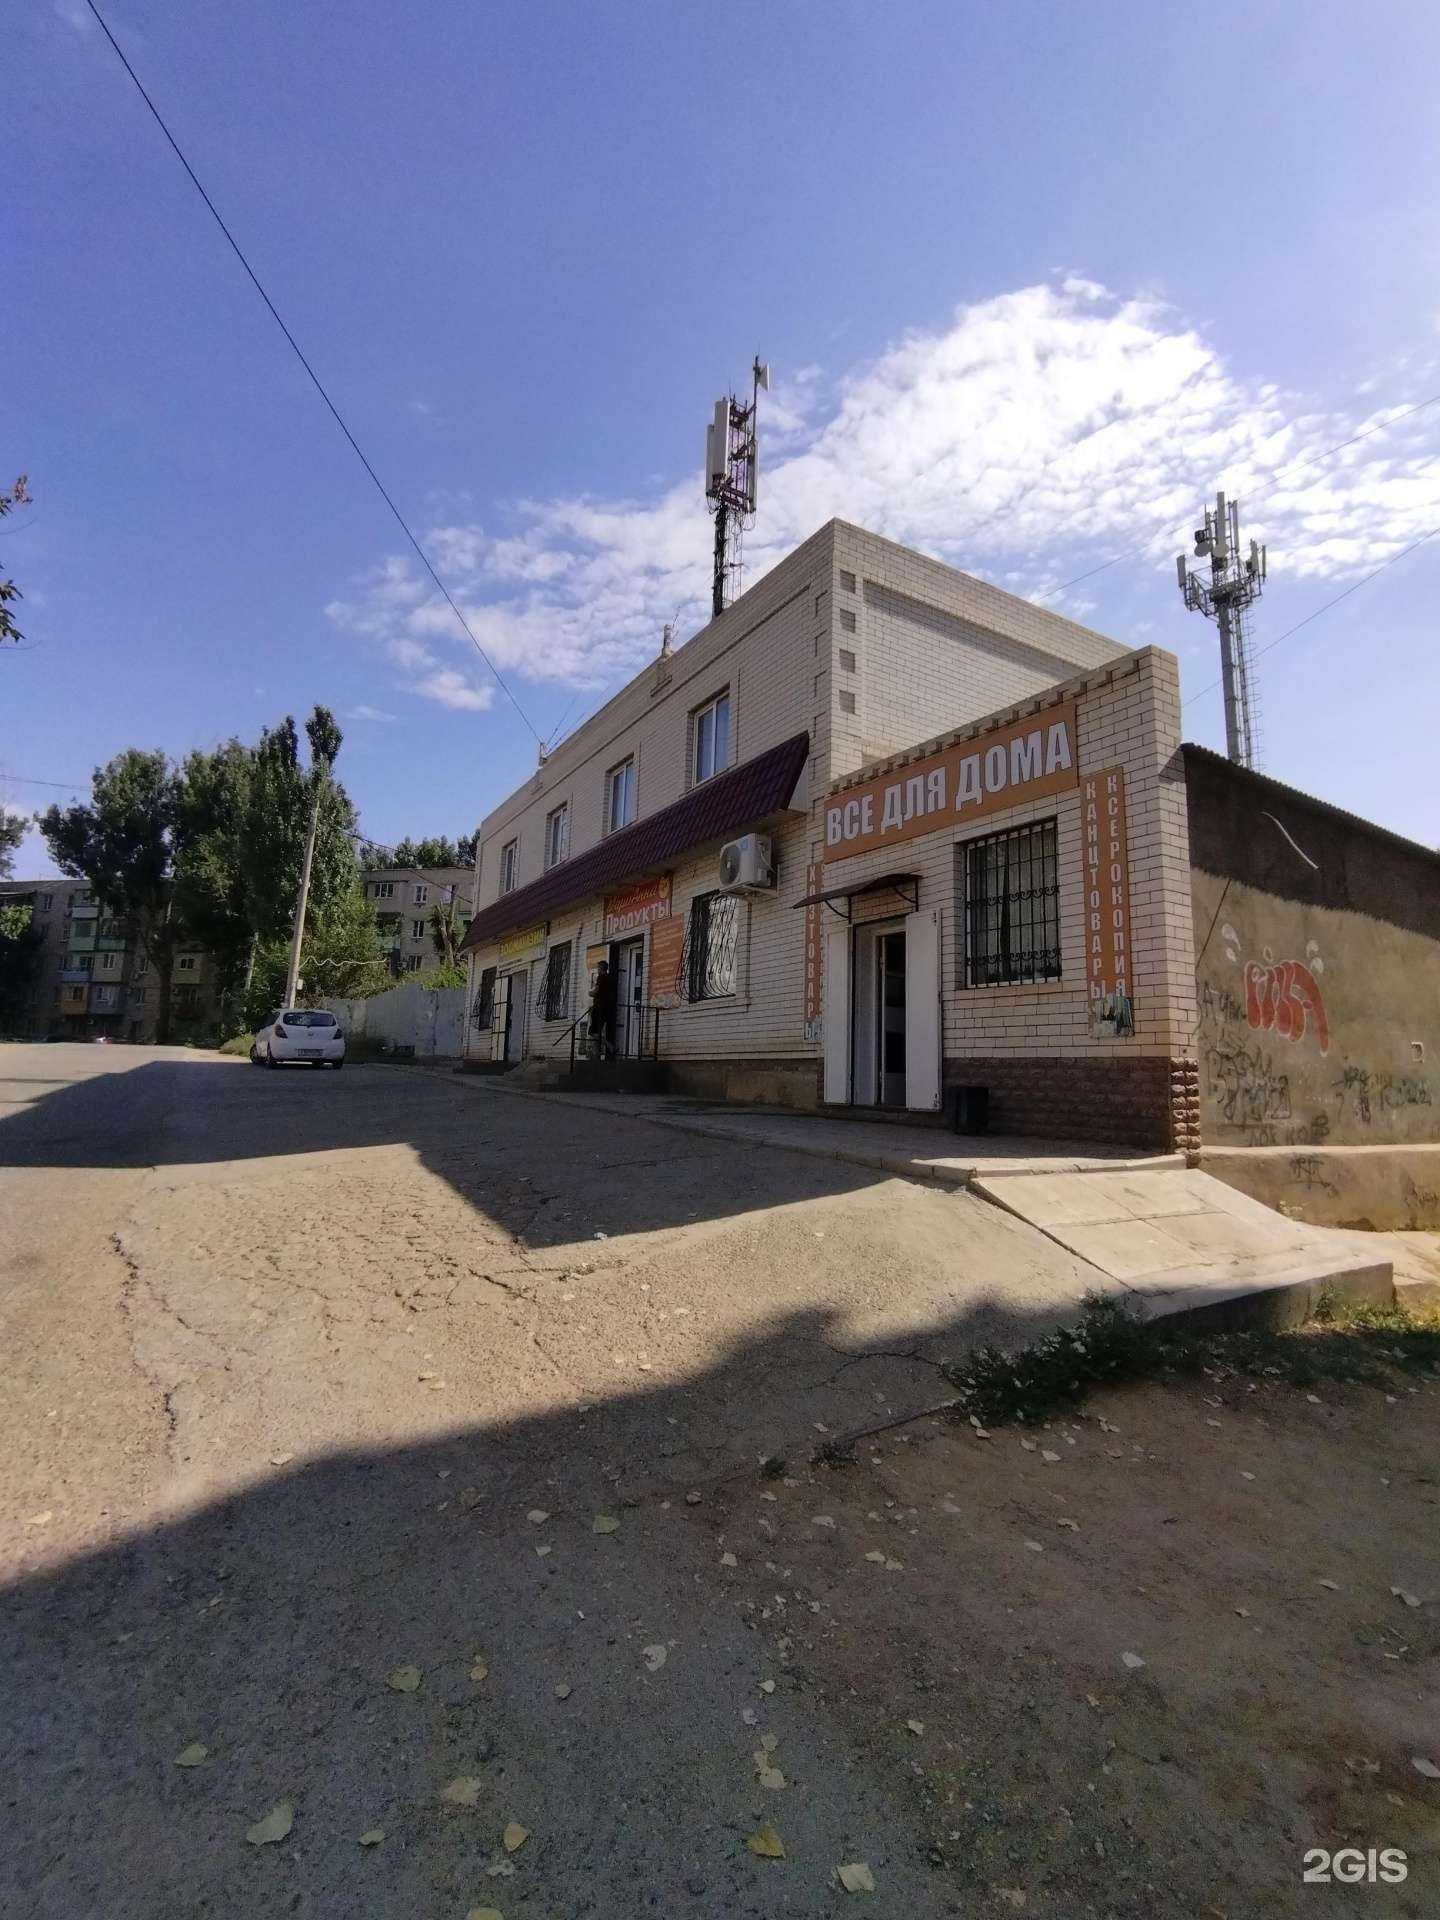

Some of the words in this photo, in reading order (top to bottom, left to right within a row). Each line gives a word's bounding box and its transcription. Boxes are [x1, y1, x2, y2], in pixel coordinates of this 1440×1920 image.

[826, 796, 874, 847] ВСЕ
[881, 766, 947, 836] ДЛЯ
[956, 721, 1073, 812] ДОМА
[1085, 781, 1107, 999] КАНЦТОВАРЫ
[1107, 775, 1127, 997] КСЕРОКОПИЯ
